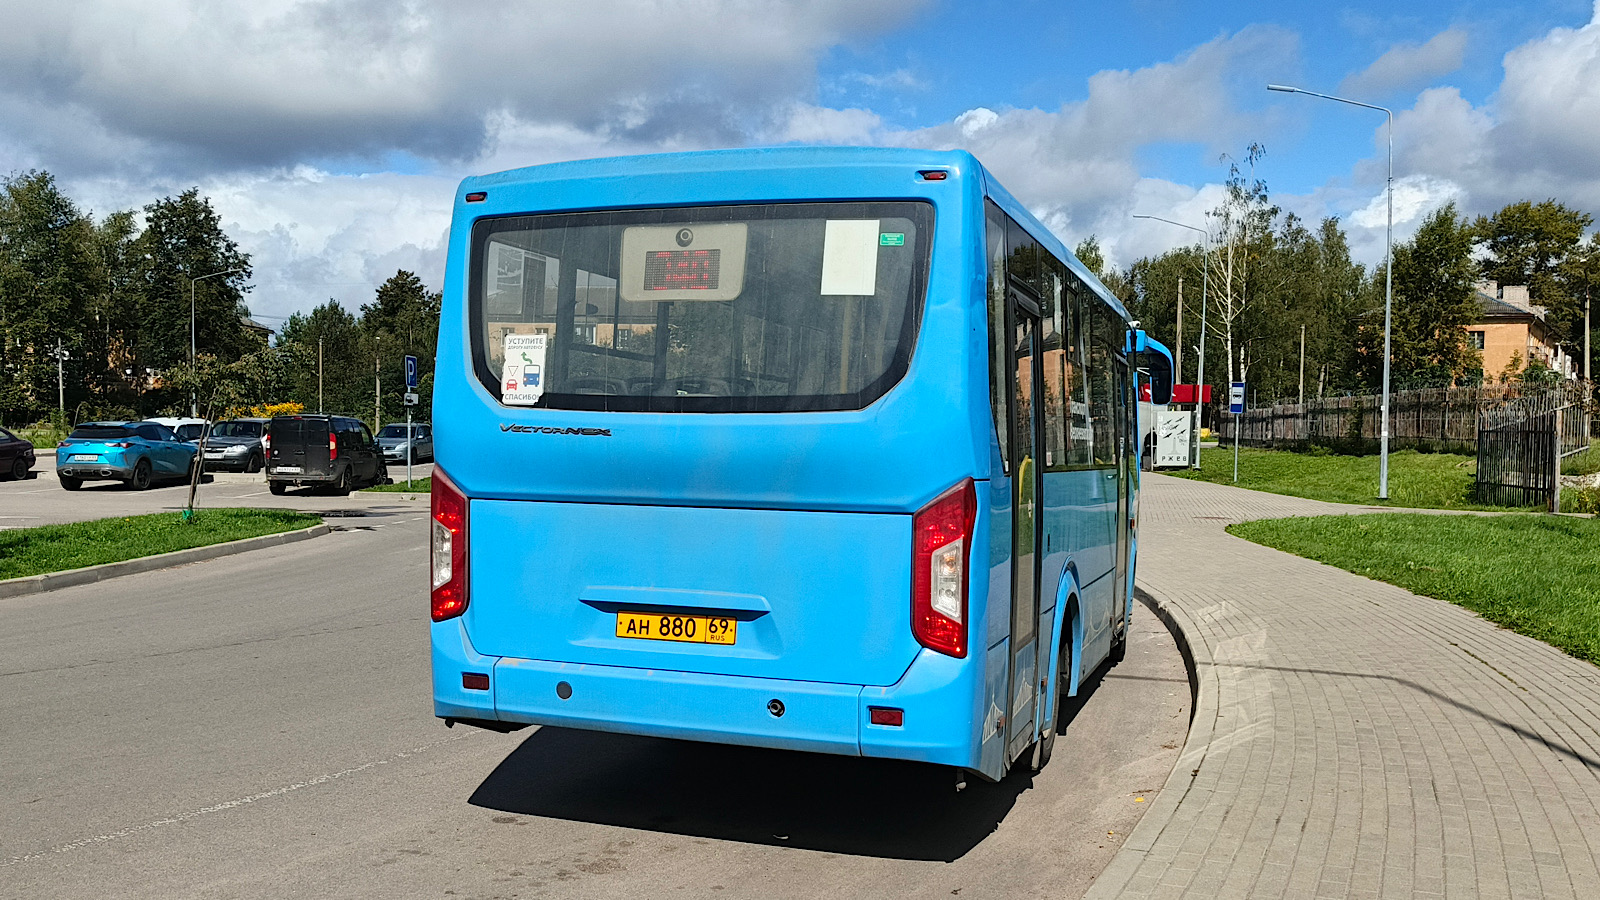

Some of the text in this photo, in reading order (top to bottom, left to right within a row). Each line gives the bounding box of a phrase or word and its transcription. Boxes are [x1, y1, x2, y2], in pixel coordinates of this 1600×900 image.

[508, 337, 544, 345] УСТУПИТЕ
[407, 360, 415, 384] P
[626, 616, 697, 638] АН 880
[708, 617, 729, 635] 69
[710, 634, 726, 642] RUS
